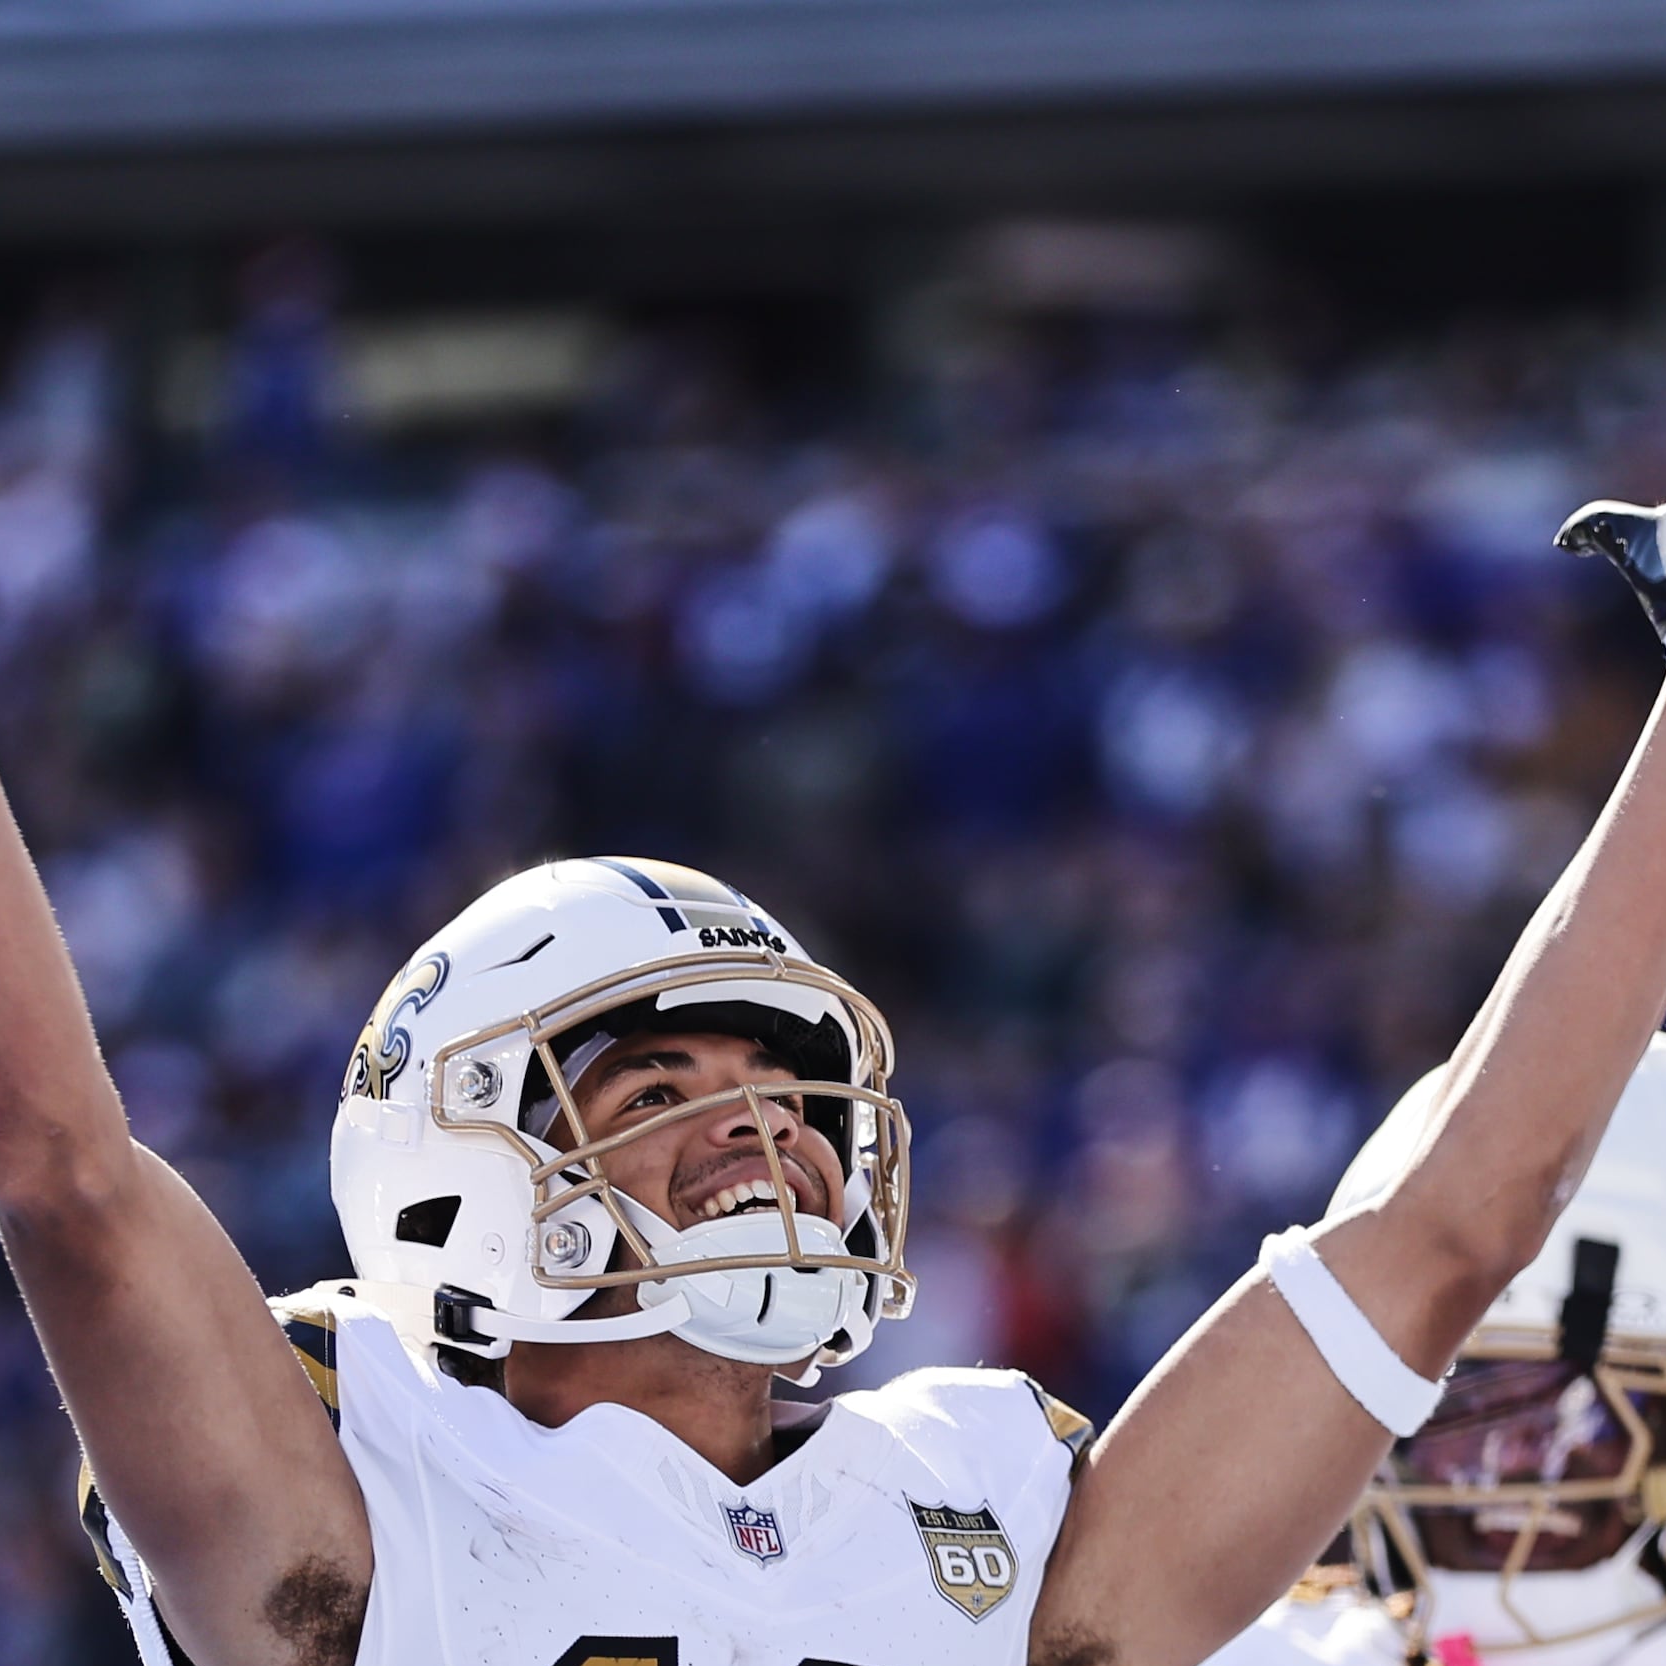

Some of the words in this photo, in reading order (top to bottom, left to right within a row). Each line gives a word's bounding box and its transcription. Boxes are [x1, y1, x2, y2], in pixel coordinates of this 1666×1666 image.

[698, 927, 787, 954] SAINTS
[735, 1526, 779, 1554] NFL
[933, 1543, 1012, 1588] 60
